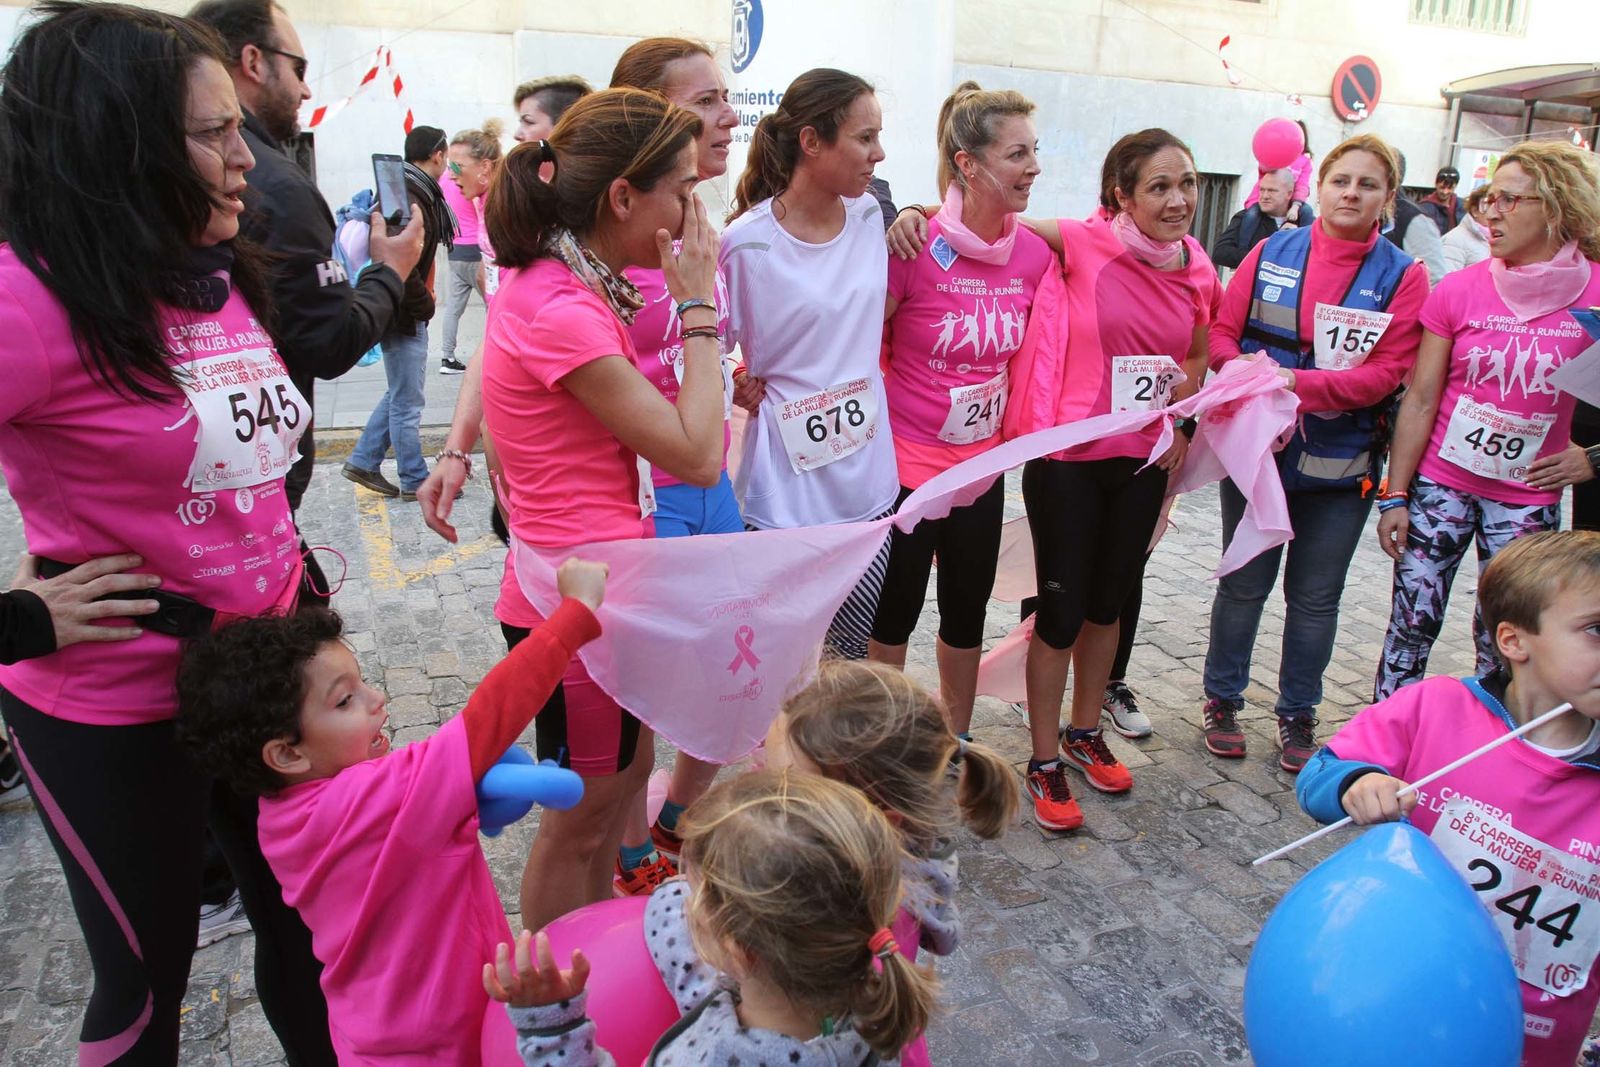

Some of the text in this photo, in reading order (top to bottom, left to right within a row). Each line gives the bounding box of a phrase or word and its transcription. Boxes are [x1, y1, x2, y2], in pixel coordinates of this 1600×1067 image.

[937, 284, 950, 293] DE
[950, 285, 960, 294] LA
[961, 287, 987, 296] MUJER
[995, 286, 1024, 296] RUNNING
[952, 277, 1024, 288] CARRERA PINK
[1326, 309, 1357, 319] CARRERA
[168, 321, 225, 340] CARRERA
[189, 335, 232, 352] MUJER
[231, 338, 238, 348] &
[1326, 326, 1379, 353] 155
[1469, 320, 1480, 330] DE
[1482, 321, 1494, 331] LA
[1495, 323, 1528, 334] MUJER
[1537, 328, 1582, 339] RUNNING
[190, 382, 206, 393] DE
[207, 377, 221, 391] LA
[221, 371, 252, 387] MUJER
[202, 359, 245, 377] CARRERA
[782, 412, 792, 421] DE
[793, 408, 803, 417] LA
[805, 401, 828, 414] MUJER
[834, 385, 867, 401] RUNNING
[794, 393, 827, 409] CARRERA
[848, 380, 867, 389] PINK
[228, 384, 300, 443] 545
[806, 399, 865, 443] 678
[964, 393, 1001, 427] 241
[1459, 408, 1469, 418] DE
[1469, 412, 1477, 420] LA
[1478, 415, 1501, 430] MUJER
[1508, 427, 1543, 438] RUNNING
[1474, 407, 1505, 424] CARRERA
[1527, 423, 1544, 432] PINK
[1464, 427, 1525, 461] 459
[1464, 812, 1480, 824] 8ª
[1480, 823, 1542, 862] CARRERA
[1450, 818, 1600, 903] DE LA MUJER & RUNNIN
[1467, 858, 1581, 949] 244
